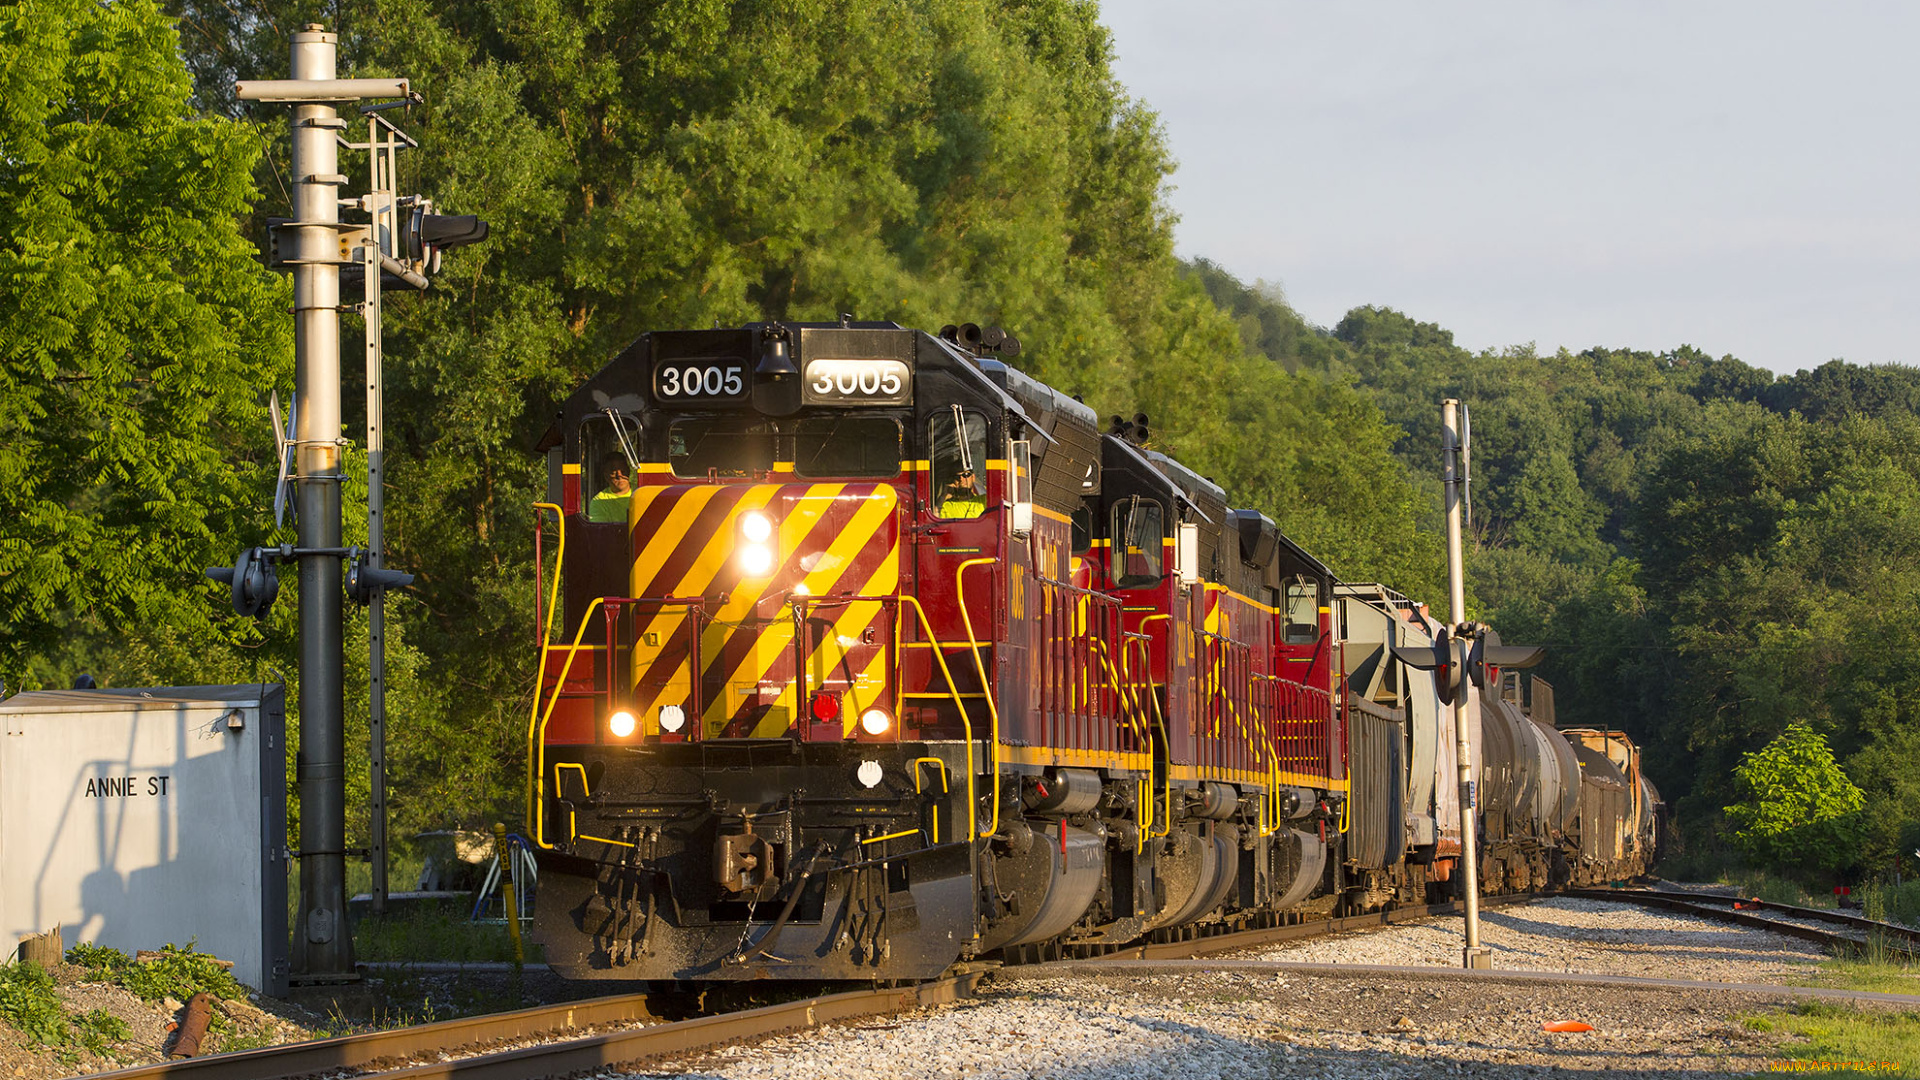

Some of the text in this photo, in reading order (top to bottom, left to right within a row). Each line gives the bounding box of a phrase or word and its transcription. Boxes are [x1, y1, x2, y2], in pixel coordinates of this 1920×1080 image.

[662, 366, 743, 396] 3005
[812, 366, 902, 395] 3005
[85, 776, 169, 797] ANNIE ST
